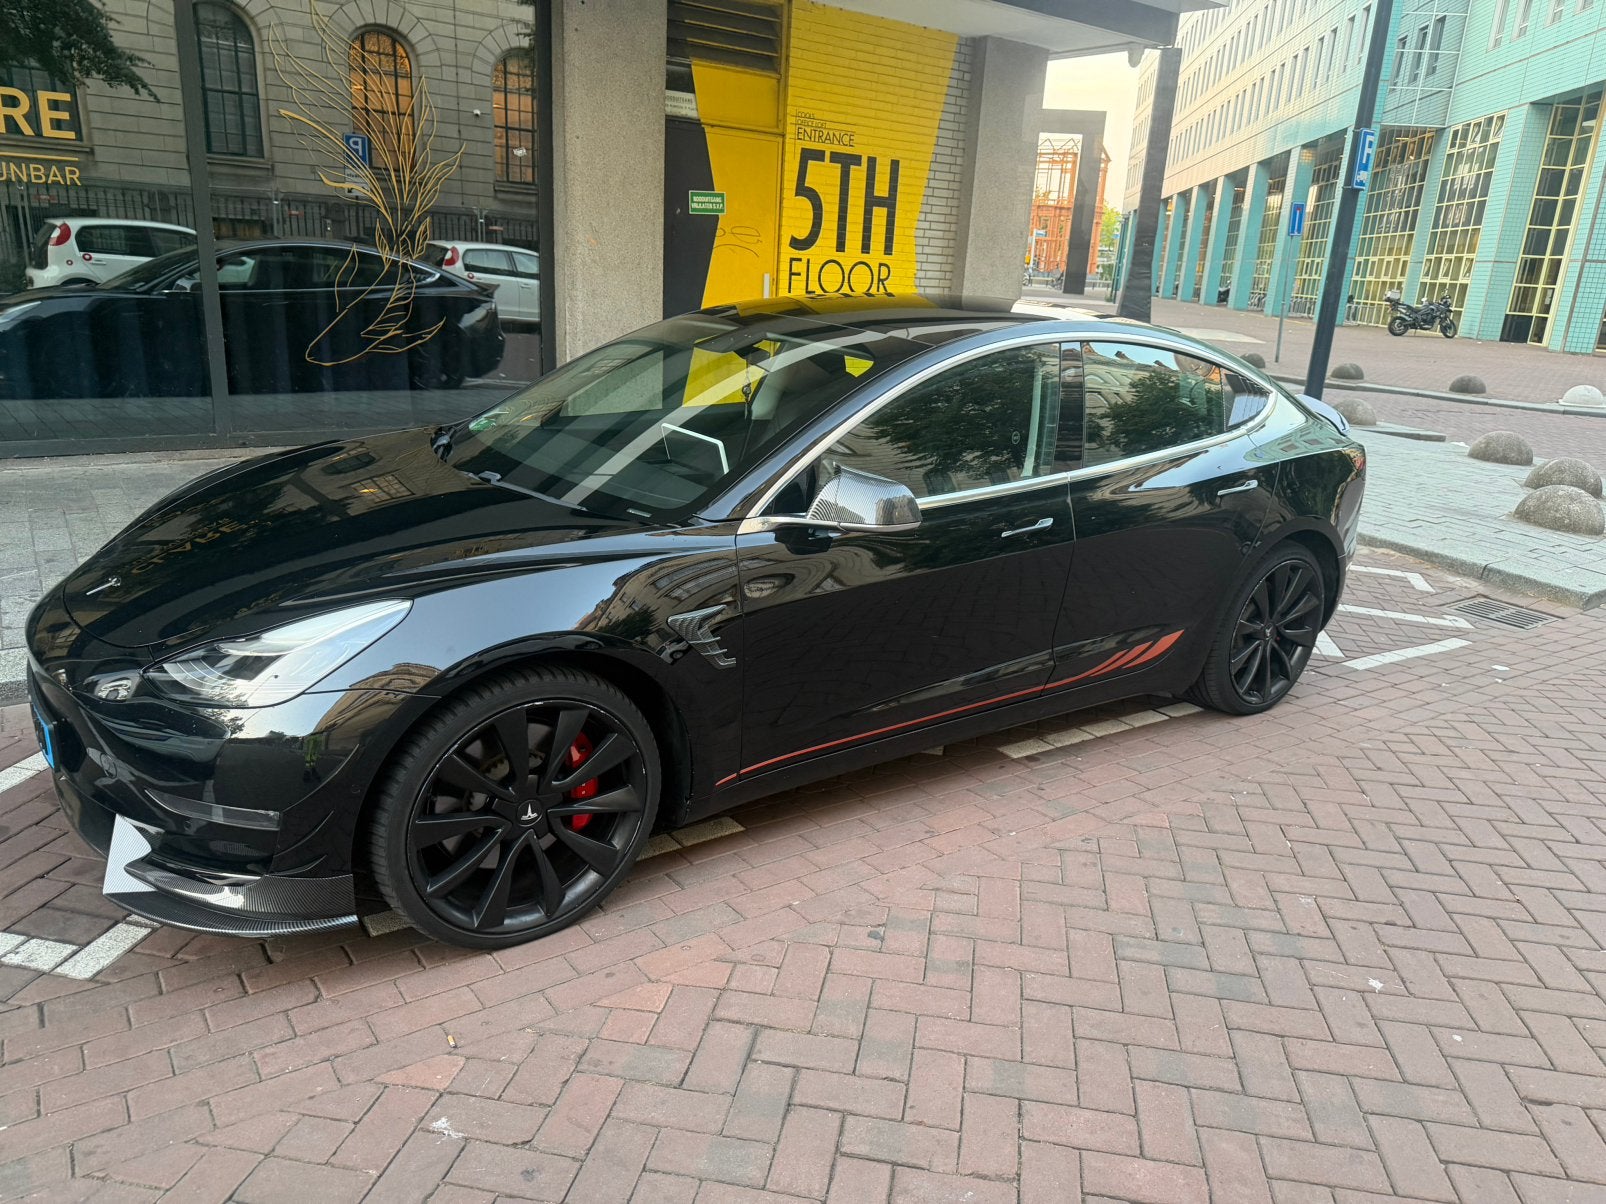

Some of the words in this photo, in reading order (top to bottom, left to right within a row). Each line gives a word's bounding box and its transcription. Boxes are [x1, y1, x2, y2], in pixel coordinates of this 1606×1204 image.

[797, 127, 855, 147] ENTRANCE
[788, 147, 900, 256] 5TH
[788, 257, 891, 294] FLOOR
